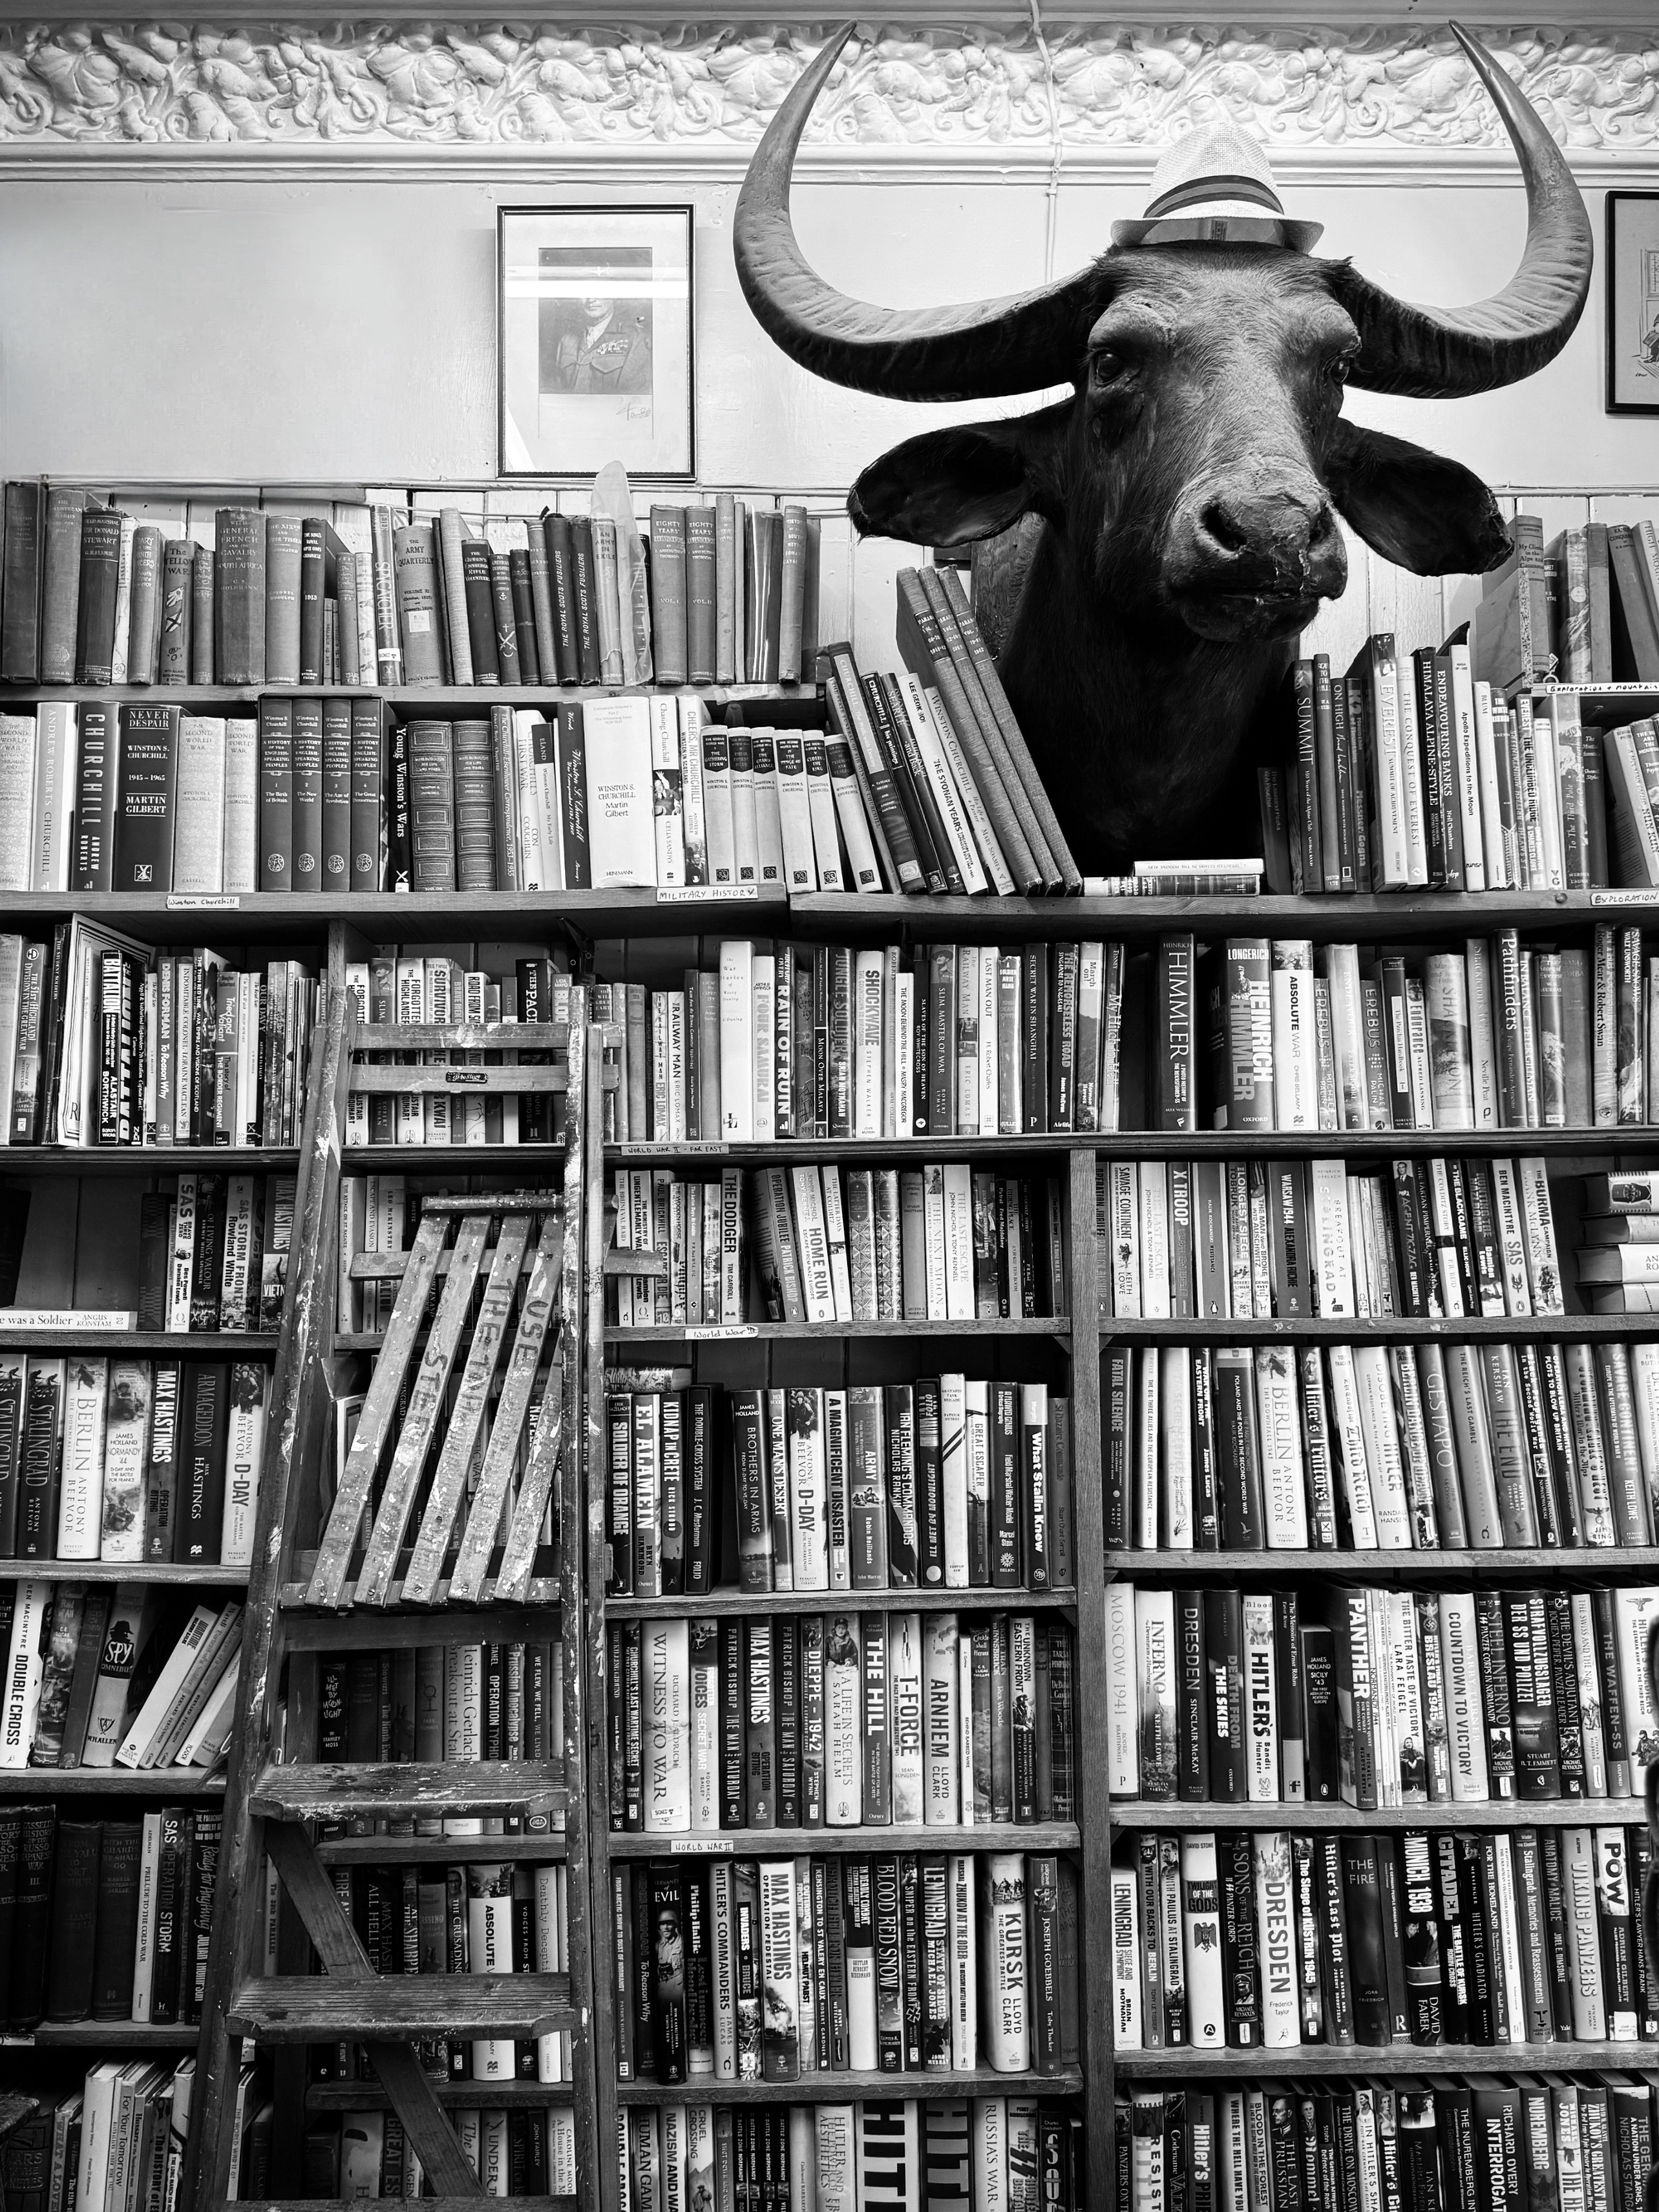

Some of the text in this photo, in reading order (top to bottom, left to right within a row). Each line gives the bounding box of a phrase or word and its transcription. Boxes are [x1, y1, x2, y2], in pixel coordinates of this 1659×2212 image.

[238, 562, 263, 570] AFRICA
[375, 562, 393, 630] SPYCATCHER
[868, 680, 886, 723] CHURCHILL
[1297, 698, 1314, 764] SUMMIT
[1335, 685, 1342, 700] ON
[1335, 704, 1344, 729] HIGH
[1380, 685, 1396, 754] EVEREST
[82, 714, 105, 824] CHURCHILL
[660, 703, 670, 762] Chasing Churchill
[1423, 661, 1438, 806] HIMALAYA ALPINE-STYLE
[1437, 670, 1452, 797] ENDEAVOURING BANKS
[395, 728, 407, 838] Young Winston's Wars
[80, 835, 88, 871] ROBERTS
[91, 836, 100, 870] ANDREW
[660, 891, 705, 900] MILITARY
[102, 958, 120, 1013] BATTALION
[1228, 949, 1269, 960] LONGERICH
[1502, 938, 1521, 1030] Pathfinders
[866, 970, 879, 1046] SHOCKWAVE
[1169, 952, 1189, 1059] HIMMLER
[1251, 981, 1273, 1082] HEINRICH
[1290, 976, 1299, 1030] ABSOLUTE
[1365, 989, 1380, 1048] EREBUS
[672, 1006, 681, 1078] RAILWAY MAN
[777, 985, 790, 1115] RAIN OF RUIN
[1231, 1000, 1255, 1100] HIMMLER
[180, 1184, 193, 1218] SAS
[724, 1175, 736, 1253] THE DODGER
[1536, 1181, 1551, 1227] BURMA
[225, 1216, 238, 1287] Rowland White
[809, 1228, 828, 1299] HOME RUN
[9, 1316, 28, 1324] was
[38, 1315, 72, 1325] Soldier
[26, 1404, 54, 1487] STALINGRAD
[75, 1397, 97, 1471] BERLIN
[194, 1374, 215, 1446] ARMAGEDDON
[1427, 1374, 1453, 1468] GESTAPO
[232, 1464, 250, 1506] D-DAY
[636, 1405, 654, 1530] EL ALAMEIN
[830, 1409, 844, 1547] MAGNIFICENT DISASTER
[105, 1641, 133, 1664] SPY
[750, 1627, 770, 1724] MAX HASTINGS
[1151, 1620, 1166, 1694] INFERNO
[1184, 1608, 1200, 1690] DRESDEN
[1348, 1598, 1370, 1698] PANTHER
[6, 1654, 28, 1746] DOUBLE CROSS
[654, 1632, 667, 1801] WITNESS TO WAR
[808, 1651, 822, 1751] DIEPPE 1942
[867, 1638, 884, 1736] THE HILL
[899, 1675, 919, 1756] T-FORCE
[931, 1679, 949, 1757] ARNHEM
[1251, 1652, 1271, 1737] HITLER'S
[158, 1820, 178, 1952] SAS STORM
[655, 1890, 679, 1902] EVIL
[1409, 1887, 1433, 1913] 1938
[1438, 1837, 1459, 1920] CITADEL
[1605, 1843, 1625, 1905] POW
[716, 1868, 731, 2010] HITLER'S COMMANDERS
[877, 1865, 897, 1988] BLOOD RED SNOW
[1005, 1913, 1023, 1990] KURSK
[1114, 1884, 1132, 1947] LENINGRAD
[1266, 1882, 1290, 1993] DRESDEN
[1572, 1861, 1597, 1997] VIKING PANZERS
[985, 2104, 998, 2204] RUSSIA'S WAR
